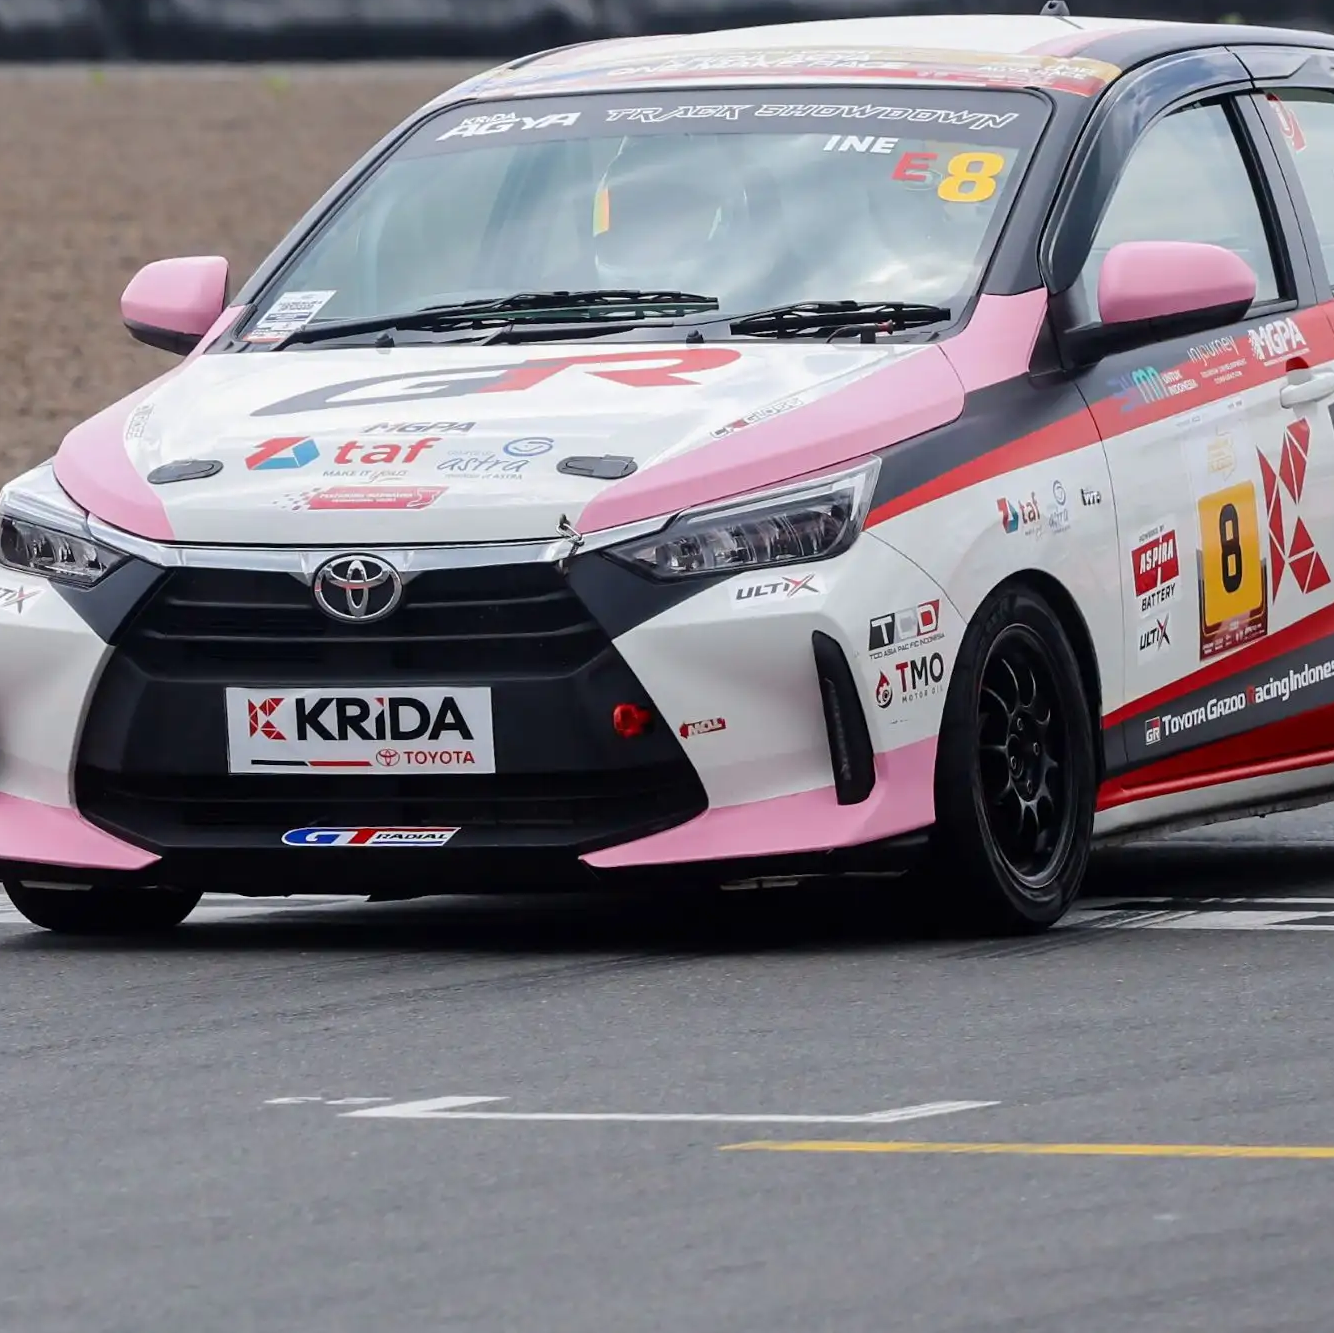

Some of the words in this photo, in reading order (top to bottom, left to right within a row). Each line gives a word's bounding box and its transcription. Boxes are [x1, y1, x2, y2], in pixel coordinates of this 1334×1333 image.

[435, 112, 581, 142] AGYA
[605, 103, 756, 124] TRACK
[754, 103, 1020, 132] SHOWDOWN
[822, 134, 900, 155] INE
[1249, 317, 1307, 361] MGPA
[360, 421, 477, 434] MGPA
[333, 437, 443, 465] taf
[436, 454, 531, 473] astra
[1219, 502, 1243, 594] 8
[1141, 582, 1176, 612] BATTERY
[895, 652, 944, 693] TMO
[902, 689, 928, 703] MOTOR
[1161, 707, 1206, 736] TOYOTA
[1206, 691, 1246, 721] GAZOO
[403, 750, 475, 765] TOYOTA
[375, 832, 448, 840] RADIAL
